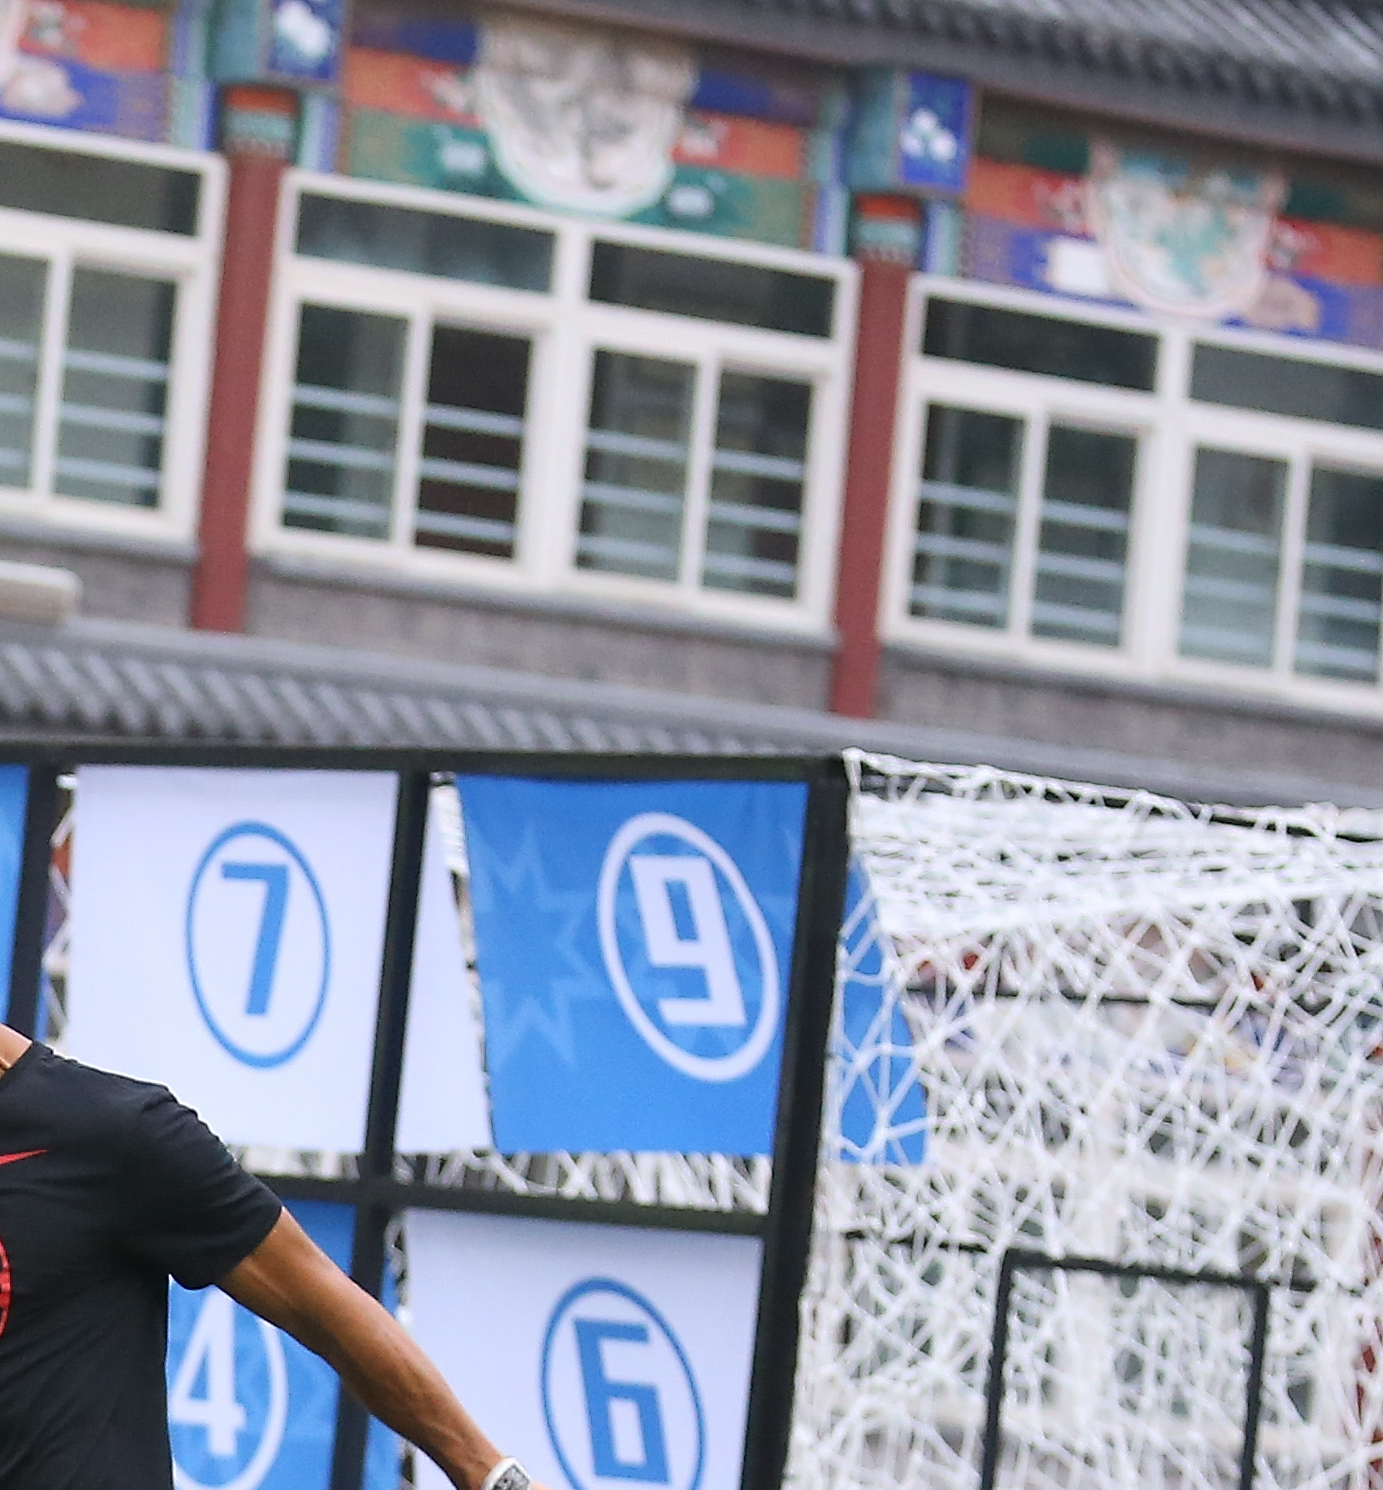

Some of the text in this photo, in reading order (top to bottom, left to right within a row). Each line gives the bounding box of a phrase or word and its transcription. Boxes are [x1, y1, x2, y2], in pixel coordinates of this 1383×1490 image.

[222, 863, 288, 1015] 7
[629, 855, 746, 1027] 9
[170, 1284, 247, 1456] 4
[573, 1319, 669, 1484] 6
